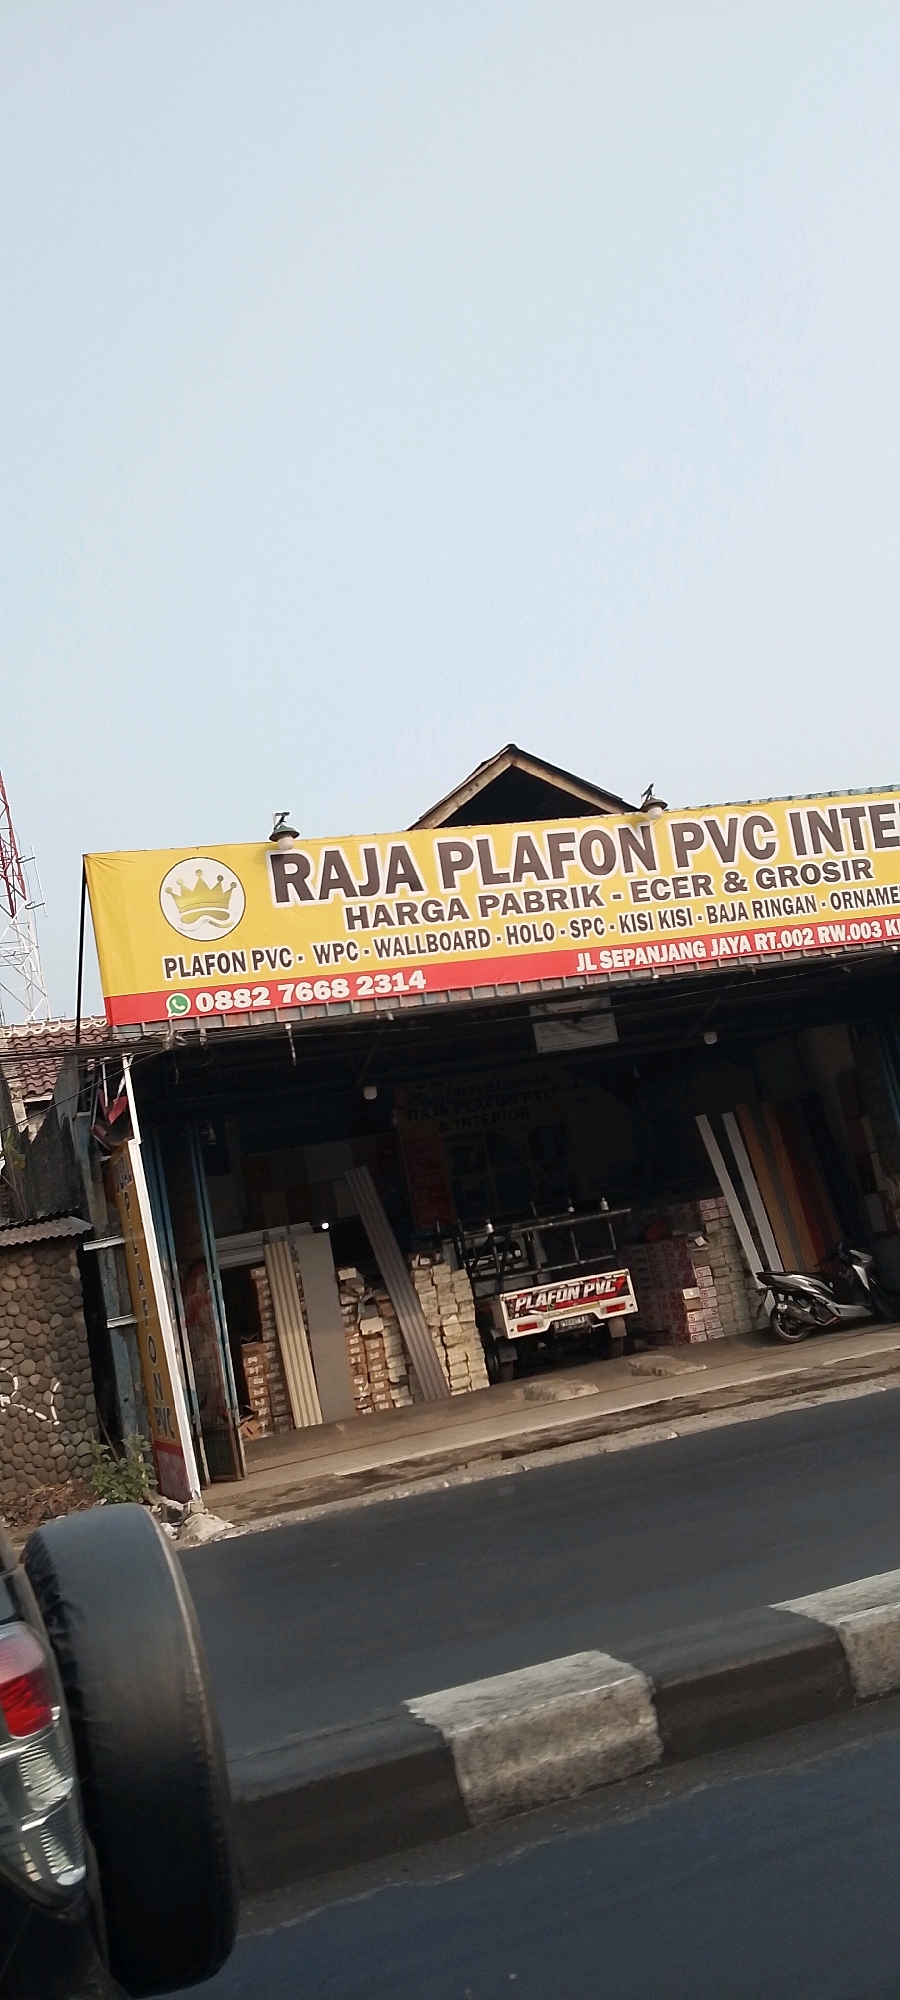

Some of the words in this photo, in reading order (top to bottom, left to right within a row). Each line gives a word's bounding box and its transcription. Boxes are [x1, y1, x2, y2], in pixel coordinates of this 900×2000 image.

[271, 846, 423, 903] RAJA
[438, 826, 657, 888] PLAFON
[671, 815, 776, 868] PVC
[789, 803, 900, 855] INTE
[345, 900, 470, 930] HARGA
[478, 884, 604, 918] PABRIK
[630, 874, 714, 903] ECER
[723, 871, 748, 893] &
[755, 858, 874, 890] GROSIR
[164, 951, 247, 979] PLAFON
[251, 947, 292, 971] PVC
[313, 941, 359, 965] WPC
[374, 928, 491, 959] WALLBOARD
[505, 922, 555, 946] HOLO
[570, 917, 605, 939] SPC
[619, 911, 654, 934] KISI
[658, 907, 693, 930] KISI
[706, 901, 749, 925] BAJA
[751, 894, 818, 920] RINGAN
[830, 886, 900, 911] ORNAME
[576, 952, 598, 972] JL
[600, 940, 707, 969] SEPANJANG
[710, 932, 752, 957] JAYA
[754, 925, 815, 951] RT.002
[818, 920, 882, 944] RW.003
[884, 918, 900, 938] K
[195, 986, 272, 1013] 0882
[277, 978, 350, 1004] 7668
[356, 970, 427, 997] 2314
[455, 1107, 531, 1130] INTERIOR
[515, 1284, 580, 1311] PLAFON
[583, 1276, 617, 1298] PVC
